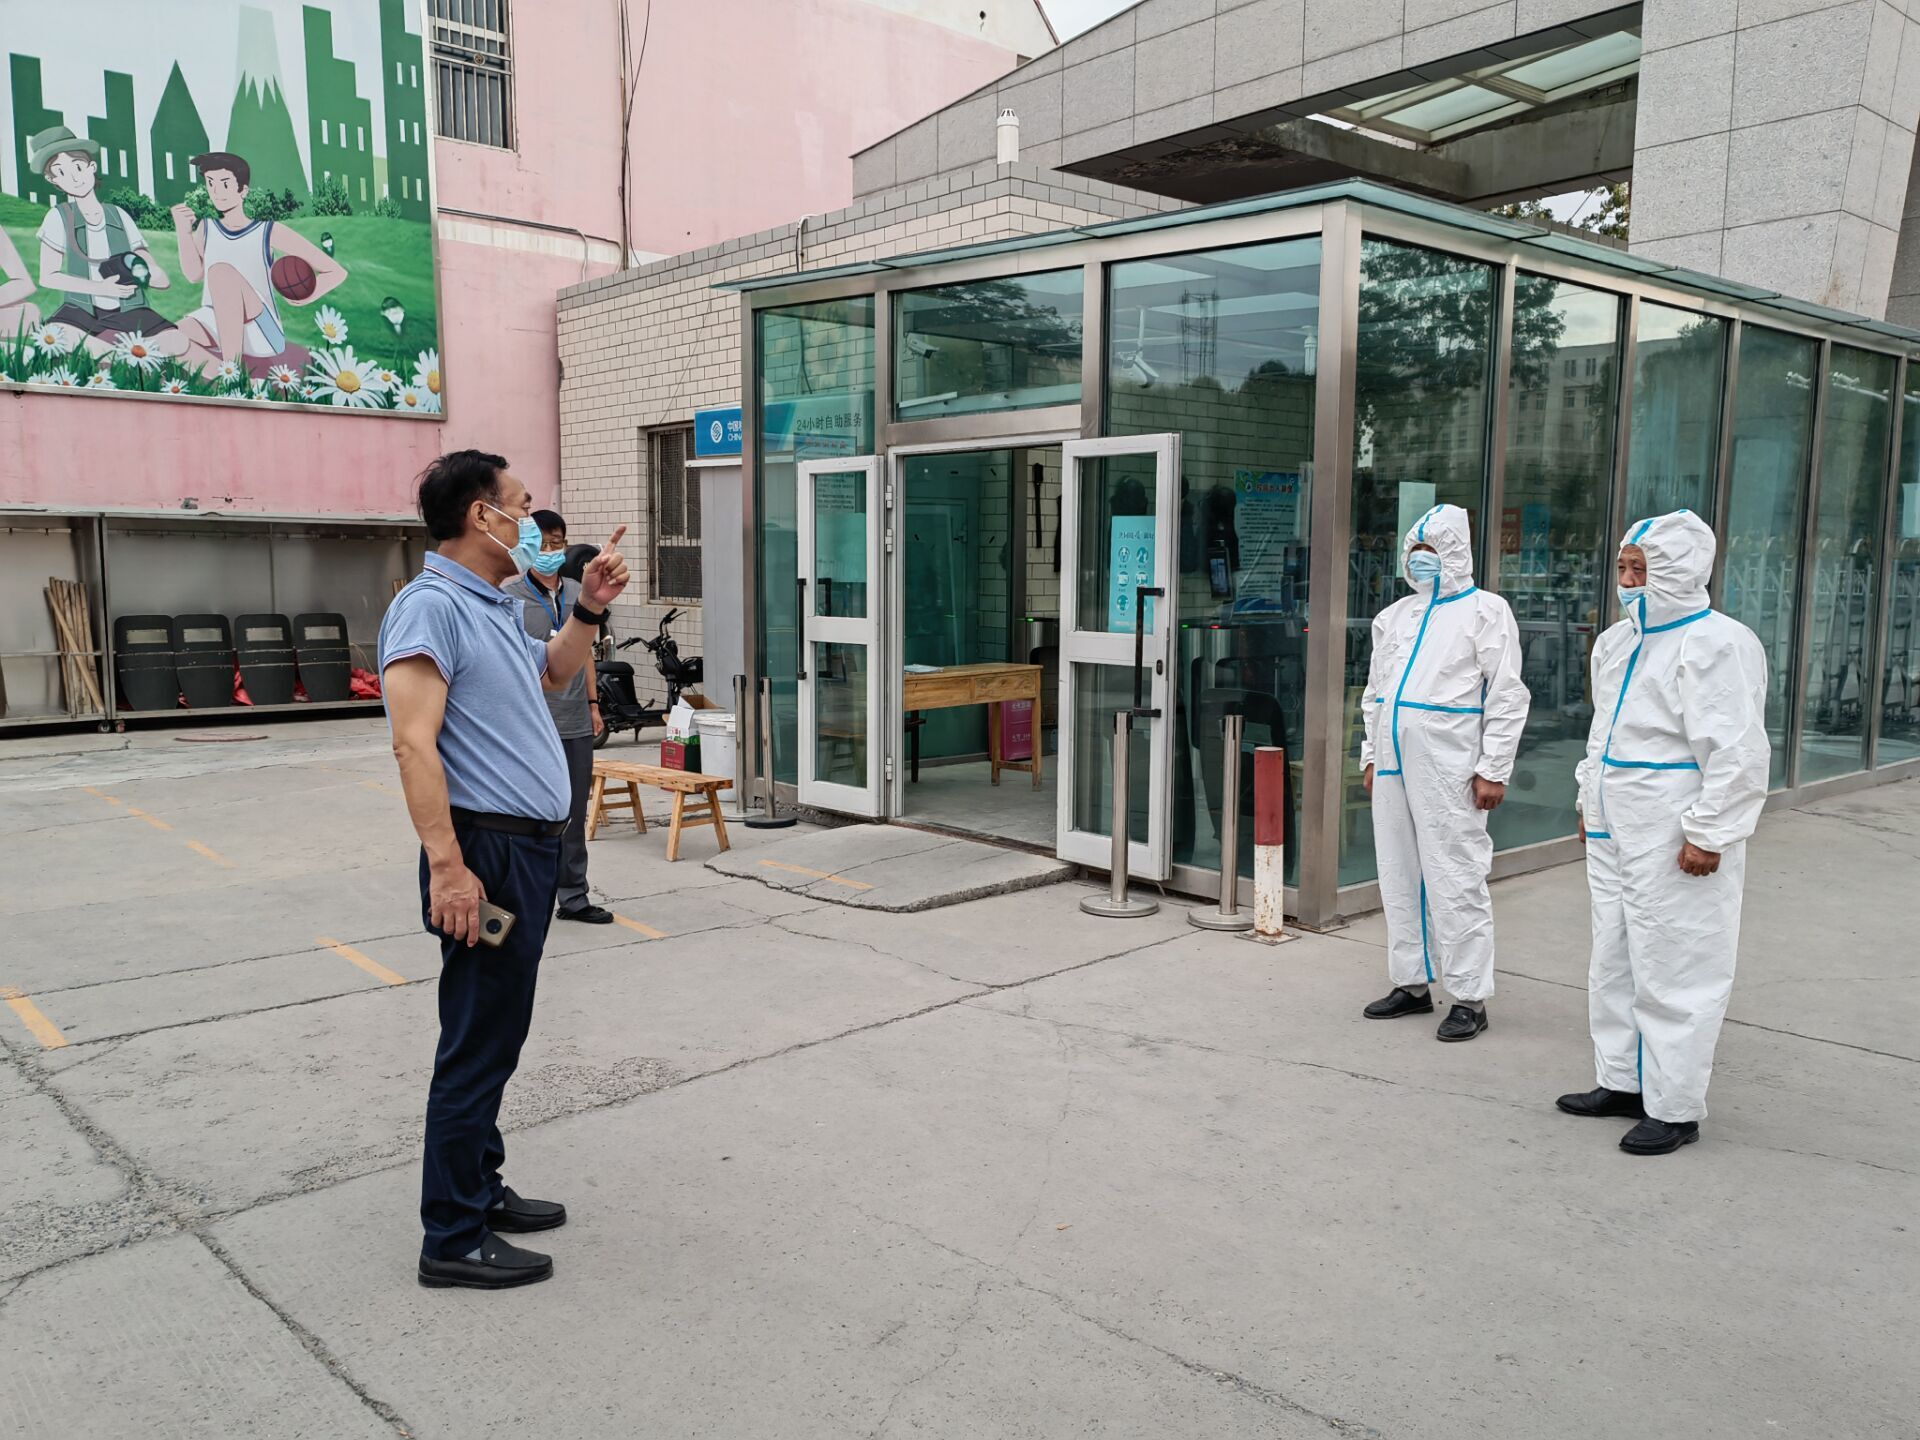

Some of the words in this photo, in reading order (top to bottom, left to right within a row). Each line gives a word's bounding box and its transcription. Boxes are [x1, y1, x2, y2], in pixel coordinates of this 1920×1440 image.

[796, 412, 862, 431] 24小时自助服务
